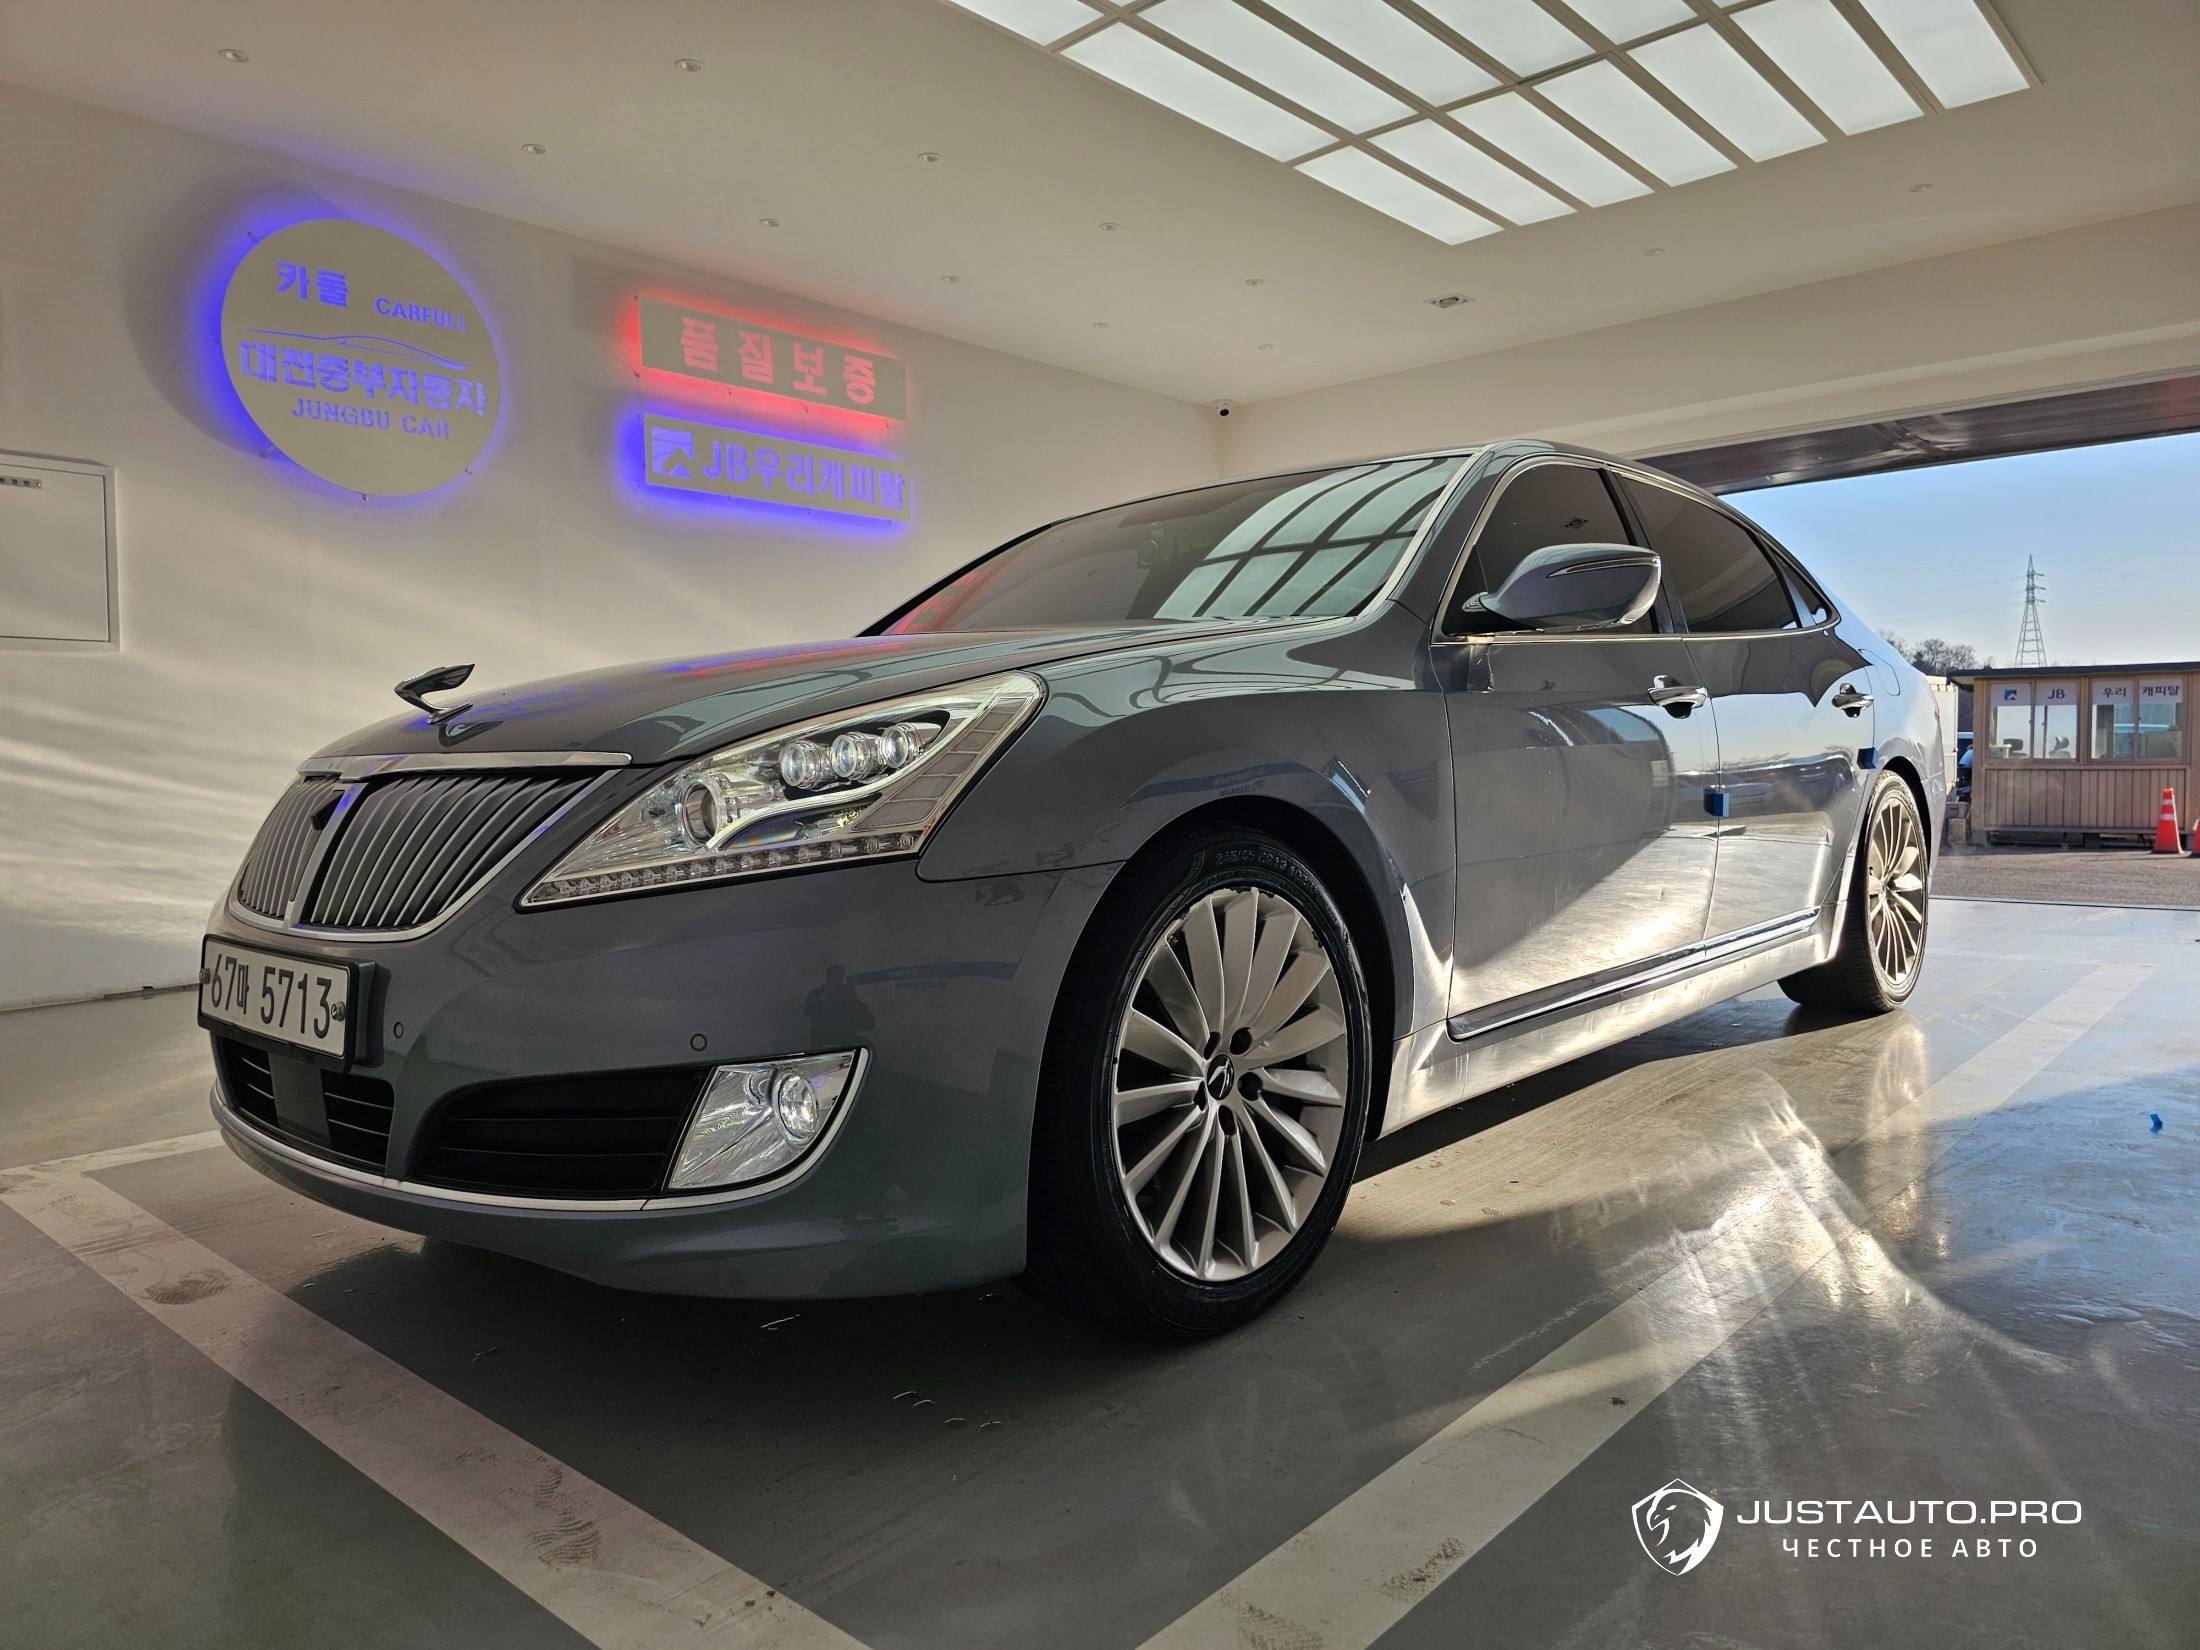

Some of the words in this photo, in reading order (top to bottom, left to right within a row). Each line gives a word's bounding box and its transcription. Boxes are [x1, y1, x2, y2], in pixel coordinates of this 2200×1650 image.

[375, 297, 468, 333] CARFULL
[291, 398, 390, 430] JUNGBU
[401, 414, 449, 439] CAR
[2047, 689, 2065, 699] JB
[2101, 687, 2127, 698] 우리
[2141, 685, 2181, 697] 캐피탈
[211, 953, 249, 1015] 67마
[260, 965, 332, 1039] 5713
